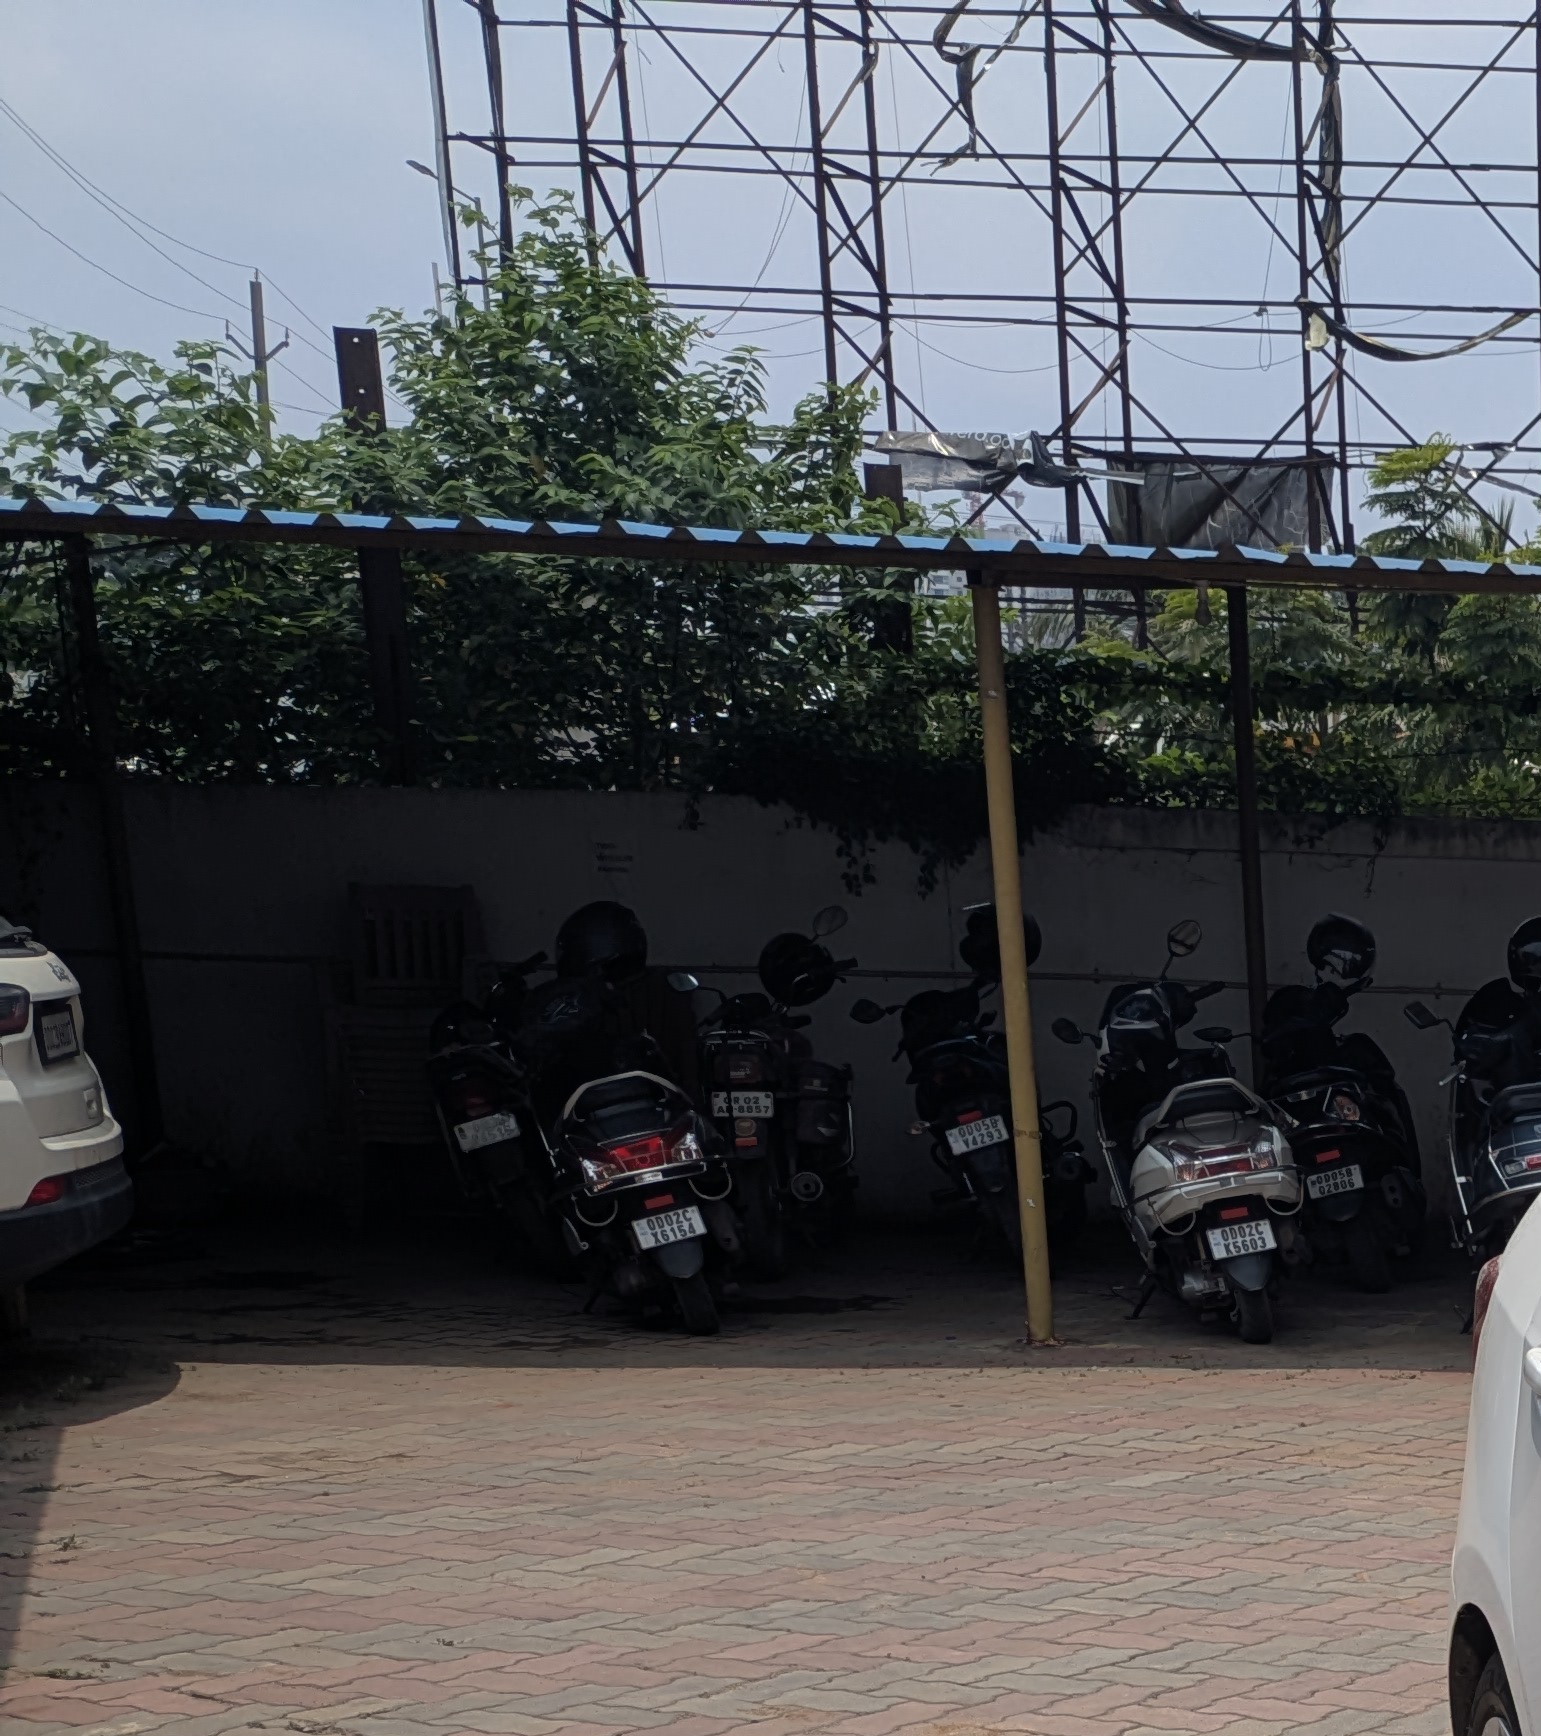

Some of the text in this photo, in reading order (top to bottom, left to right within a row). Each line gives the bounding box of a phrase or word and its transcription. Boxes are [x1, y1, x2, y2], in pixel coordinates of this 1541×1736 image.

[646, 1208, 692, 1231] OD02C
[650, 1222, 697, 1245] X6154
[1220, 1222, 1264, 1242] OD02C
[1223, 1236, 1267, 1256] K5603
